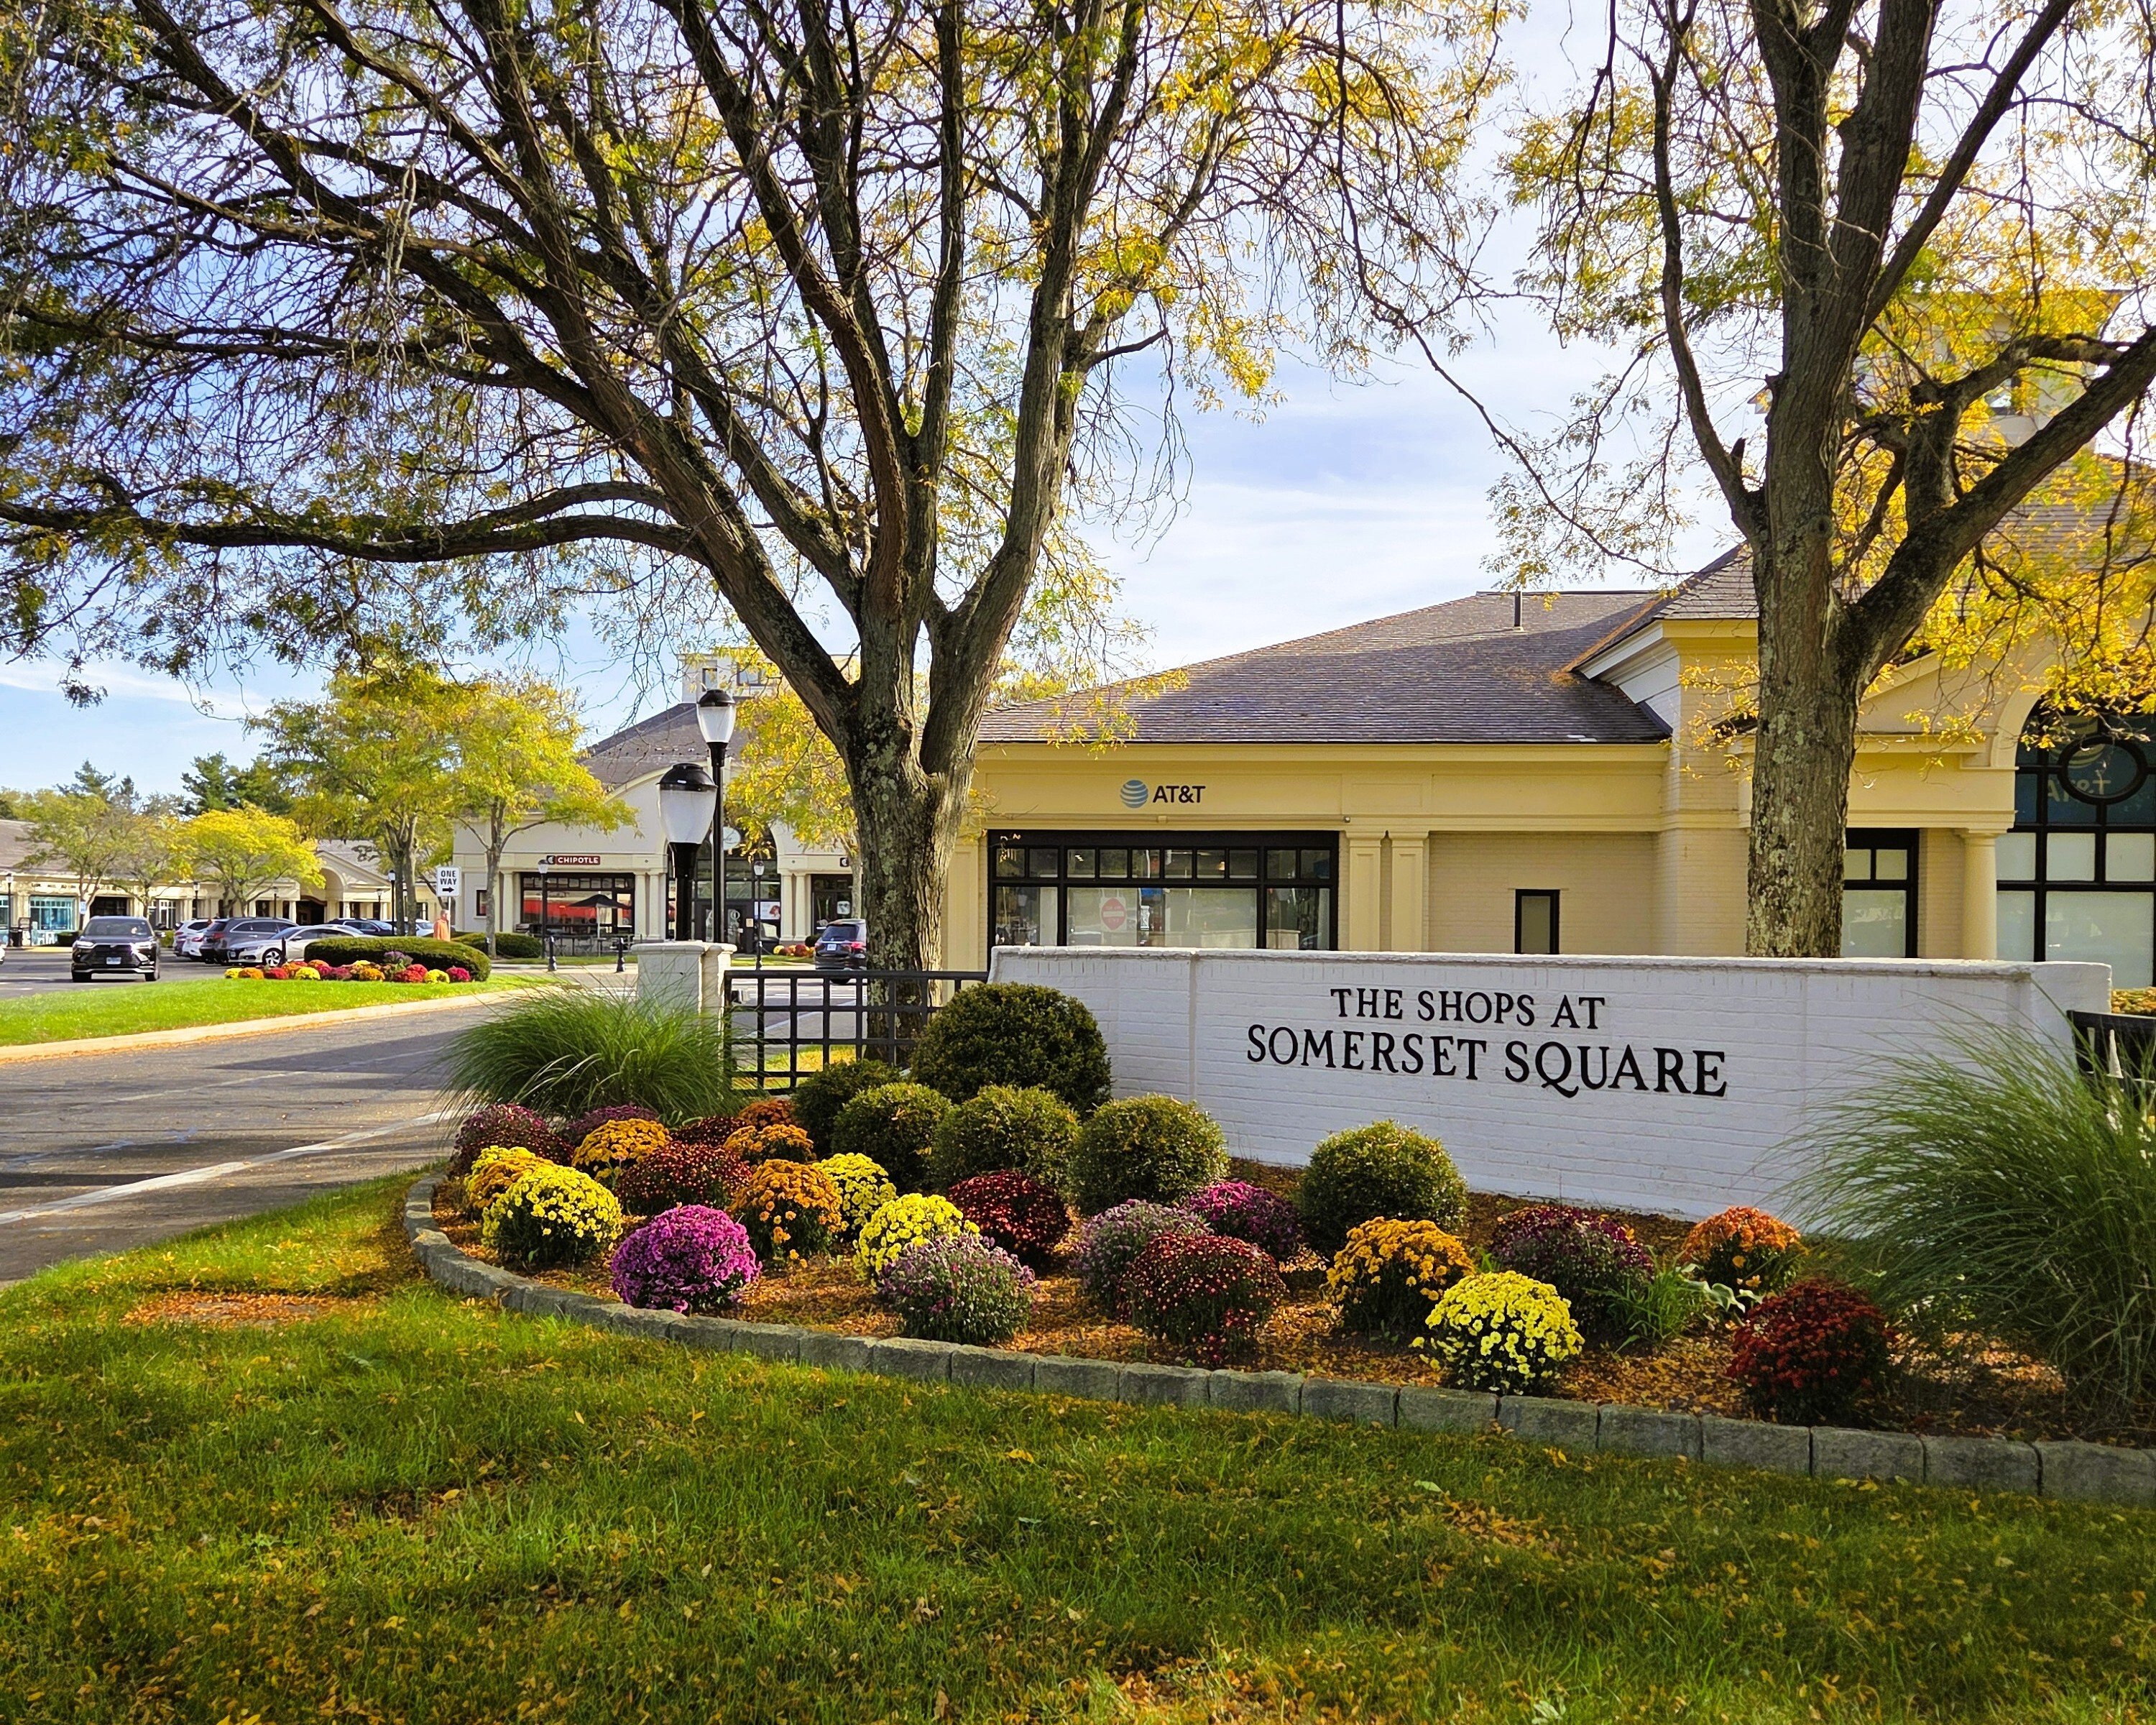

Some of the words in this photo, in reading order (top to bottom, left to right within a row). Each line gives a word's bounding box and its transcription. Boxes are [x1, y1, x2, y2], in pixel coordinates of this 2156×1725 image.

[1152, 785, 1206, 804] AT&T
[1330, 988, 1404, 1019] THE
[1417, 990, 1535, 1027] SHOPS
[1550, 995, 1606, 1030] AT
[1247, 1024, 1488, 1081] SOMERSET
[1505, 1040, 1728, 1099] SQUARE
